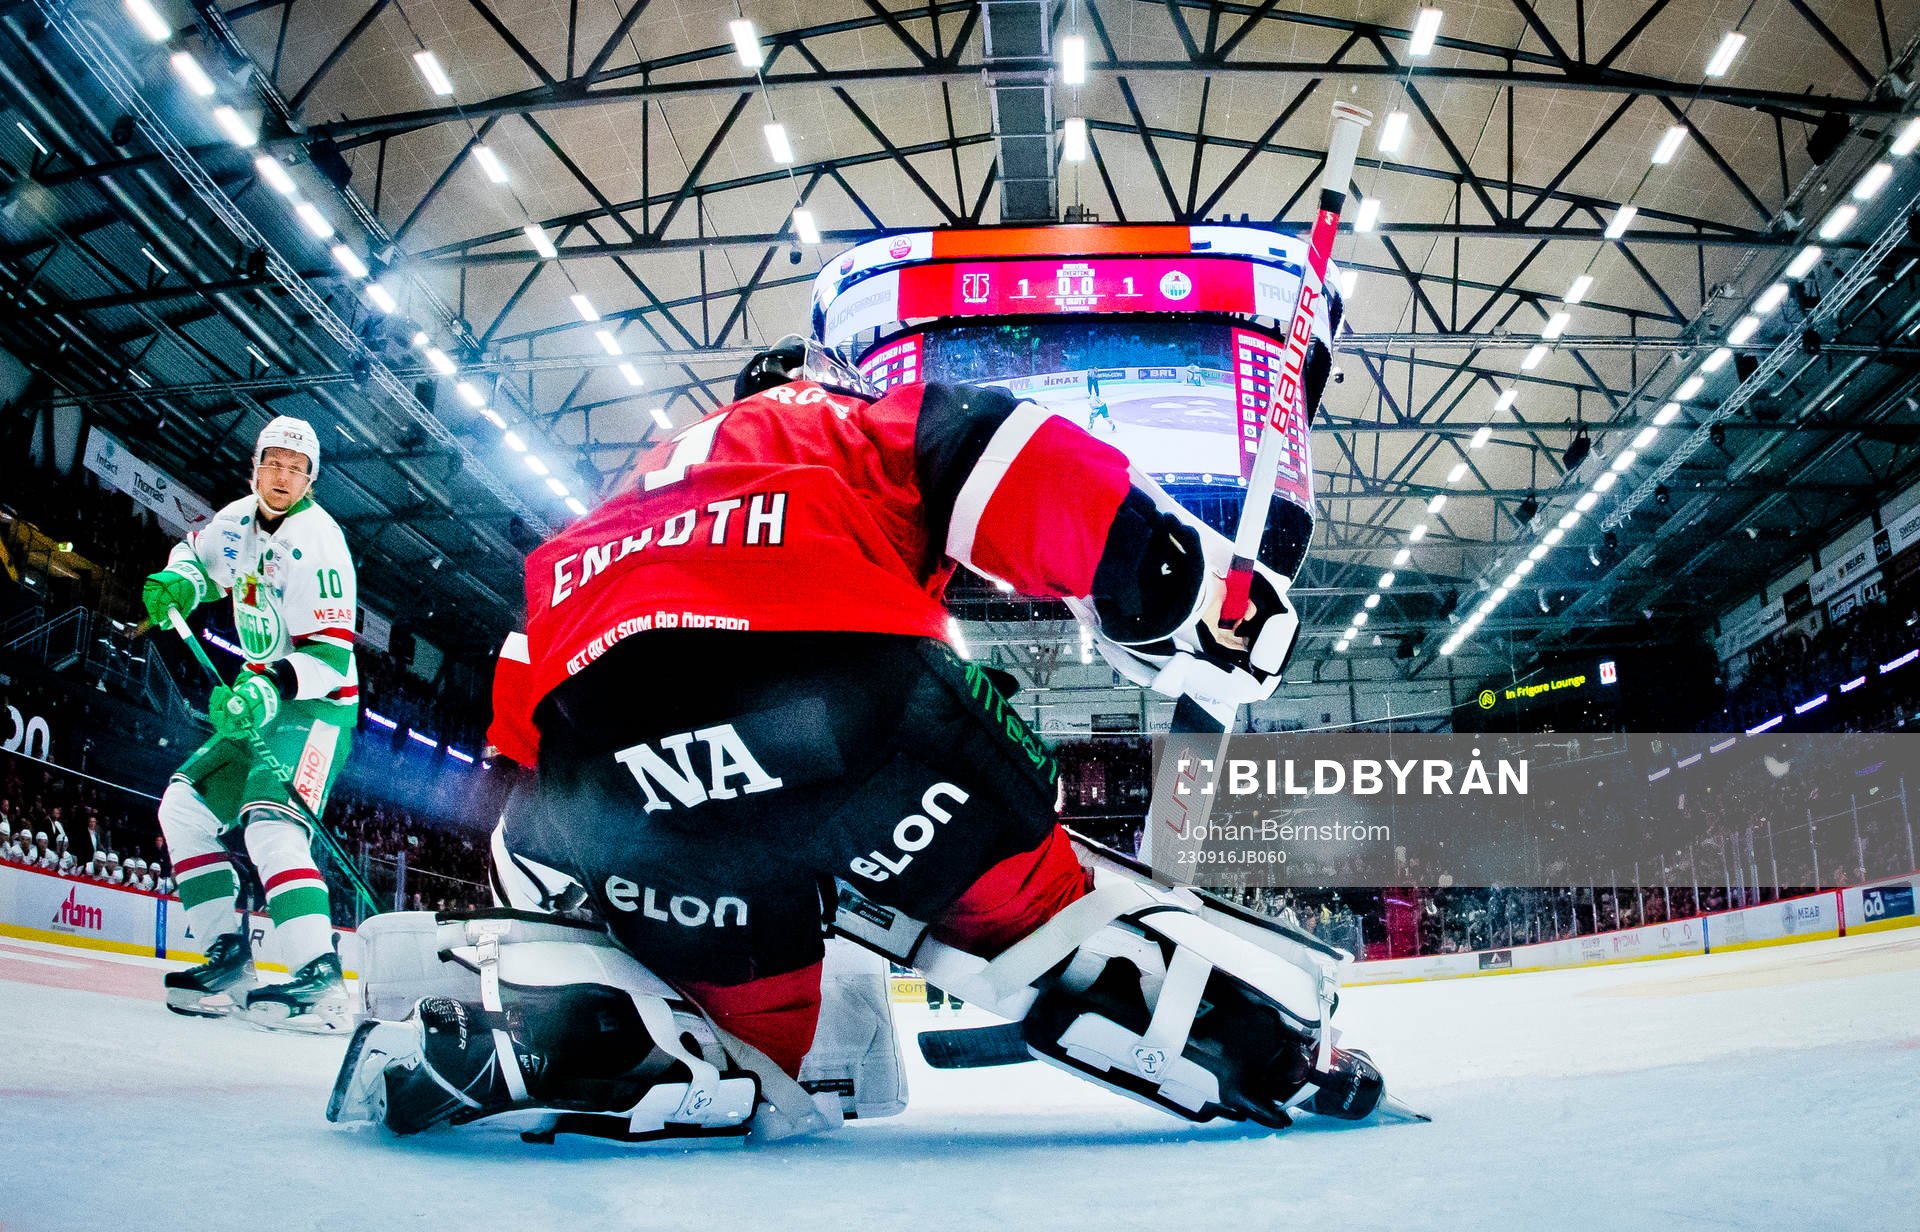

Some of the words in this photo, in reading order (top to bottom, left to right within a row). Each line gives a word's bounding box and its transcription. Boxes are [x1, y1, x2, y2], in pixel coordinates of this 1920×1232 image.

[1017, 279, 1029, 295] 1
[1123, 277, 1134, 294] 1
[134, 471, 165, 503] Thomas
[316, 568, 342, 598] 10
[566, 649, 590, 676] DET
[617, 615, 652, 640] SOM
[1550, 675, 1586, 690] Lounge
[614, 723, 783, 815] NA
